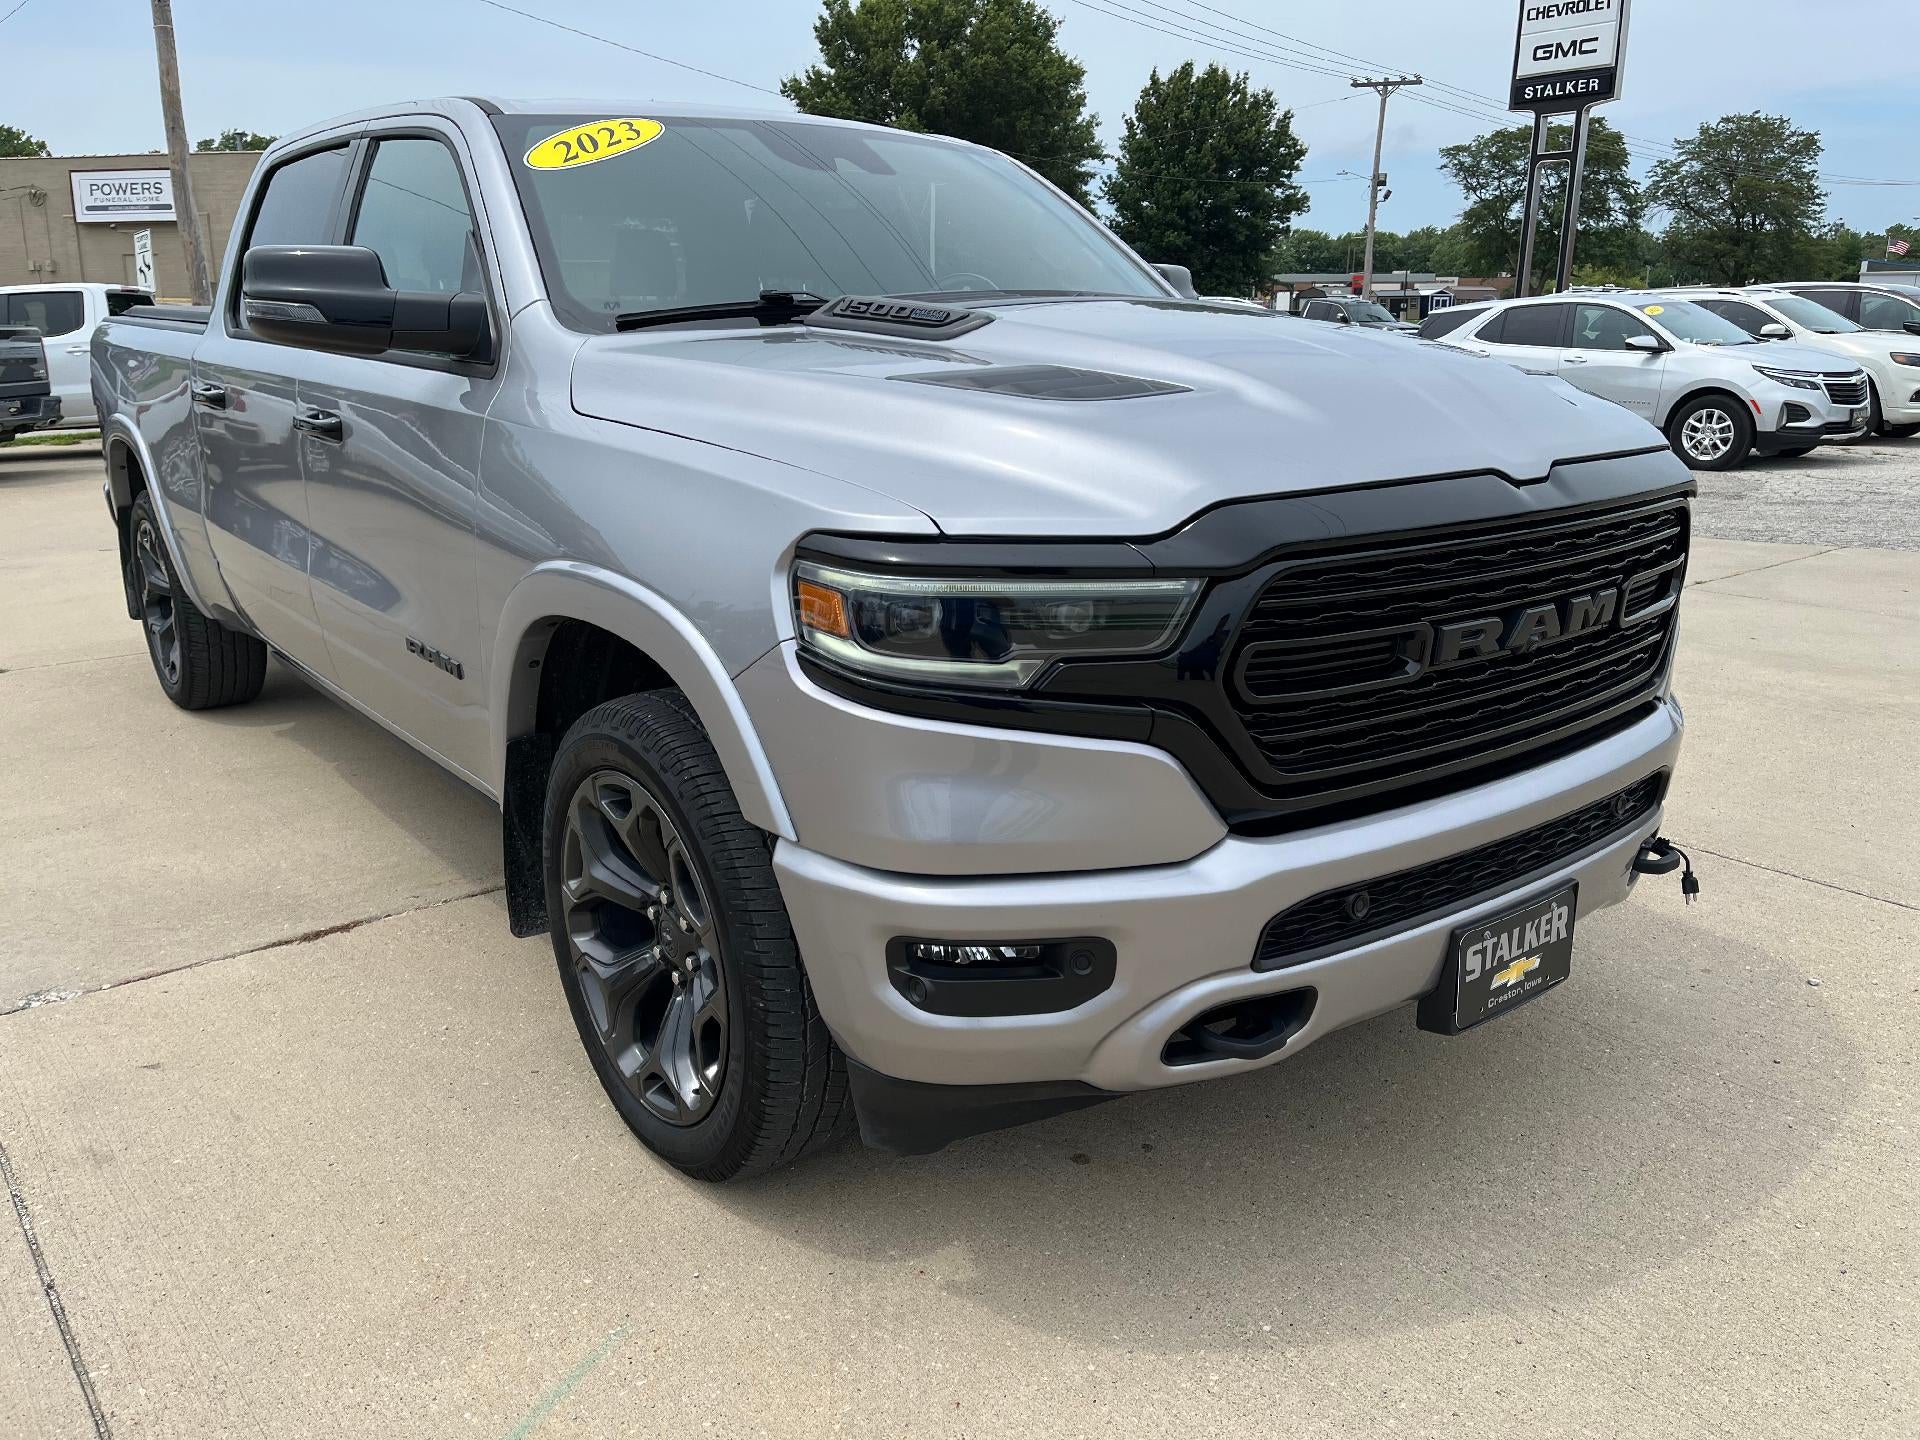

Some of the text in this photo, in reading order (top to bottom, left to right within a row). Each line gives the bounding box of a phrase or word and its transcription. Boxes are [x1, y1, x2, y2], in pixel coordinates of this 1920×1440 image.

[1532, 37, 1599, 61] GMC
[1524, 78, 1600, 99] STALKER
[553, 121, 641, 163] 2023
[89, 182, 163, 196] POWERS
[838, 299, 911, 319] 1500
[1431, 588, 1618, 666] RAM
[1465, 905, 1569, 983] STALKER
[1524, 976, 1543, 991] Iowa
